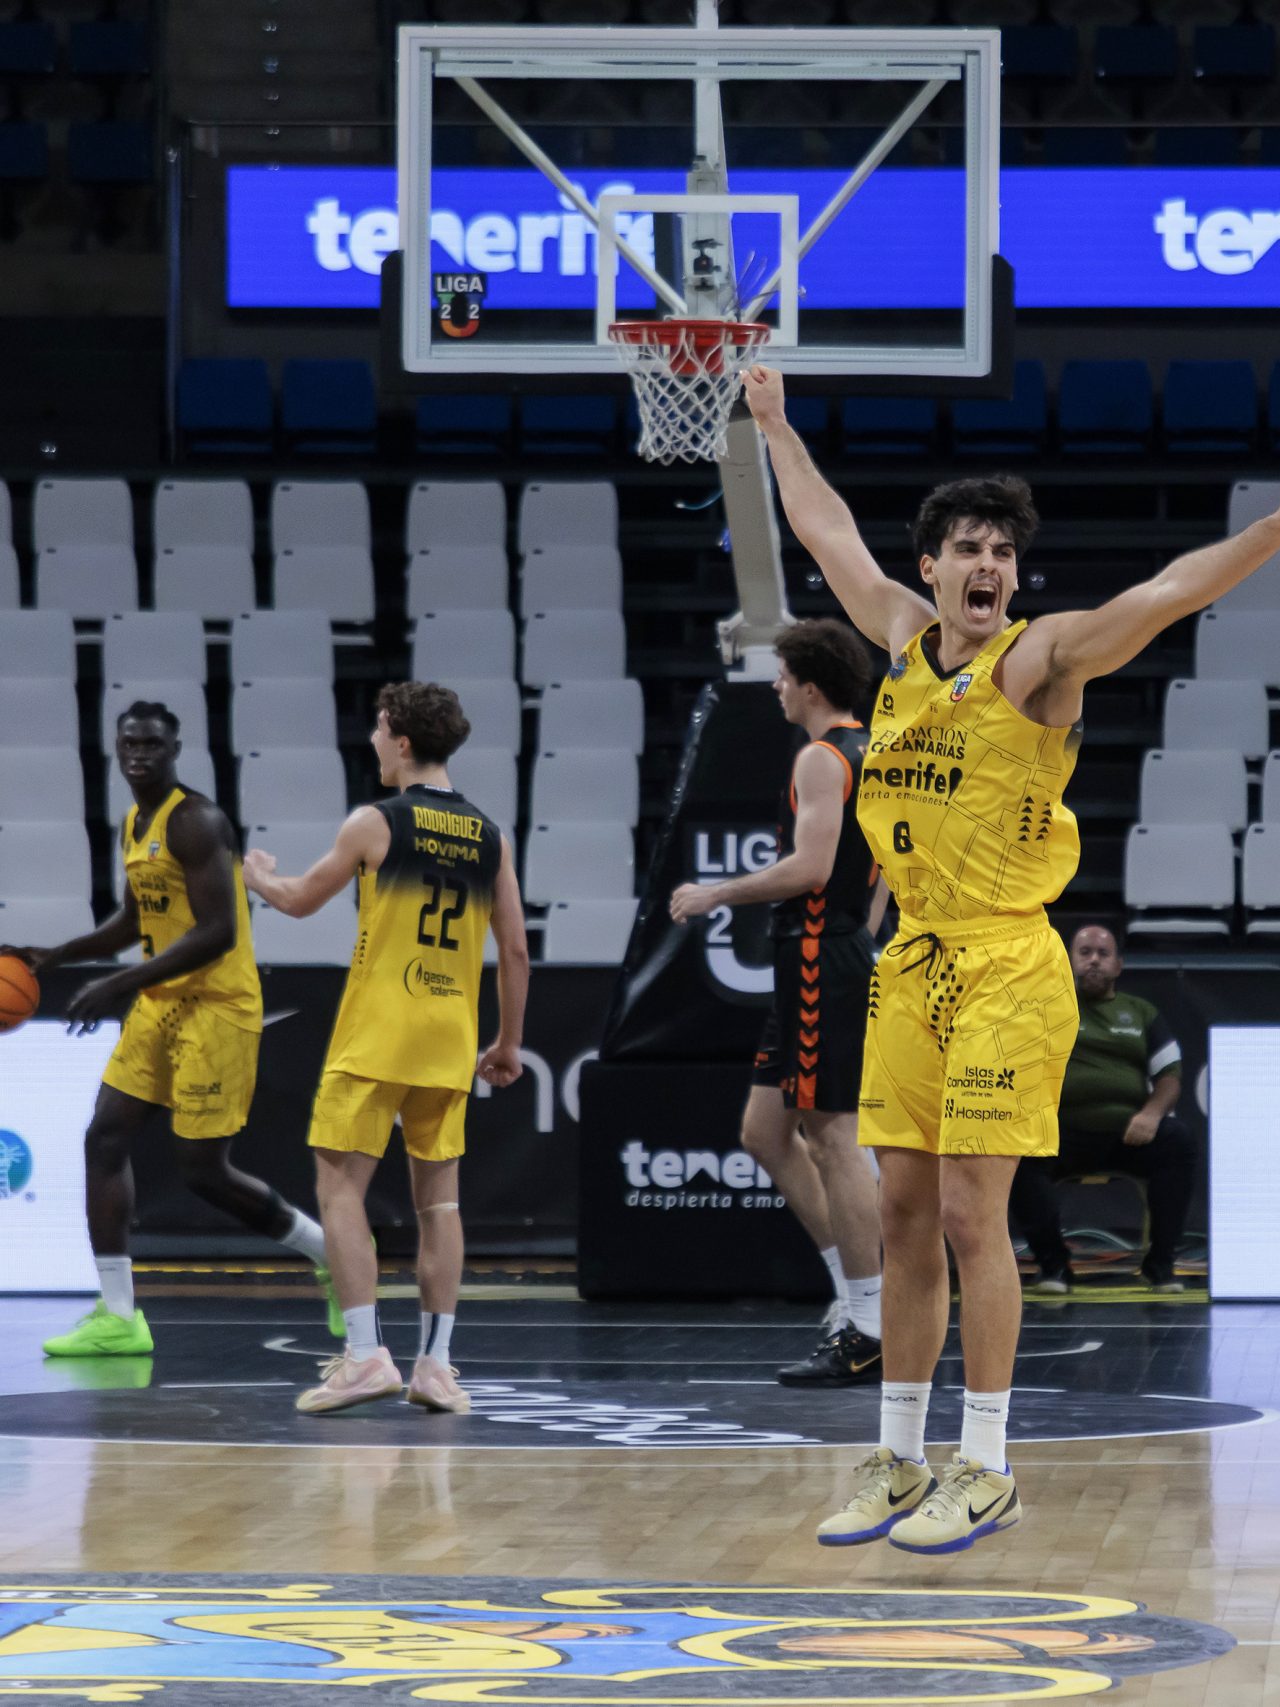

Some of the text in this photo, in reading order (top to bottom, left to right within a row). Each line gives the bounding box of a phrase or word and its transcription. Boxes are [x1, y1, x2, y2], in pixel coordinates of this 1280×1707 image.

[436, 276, 483, 293] LIGA
[879, 726, 968, 746] FDACIÓN
[889, 741, 965, 761] CANARIAS
[413, 806, 483, 842] RODRÍGUEZ
[414, 836, 480, 864] HOVIMA
[697, 832, 779, 874] LIG
[417, 872, 469, 951] 22
[707, 904, 733, 944] 2
[946, 1076, 994, 1090] Canarias
[965, 1066, 995, 1079] Islas
[955, 1106, 1013, 1123] Hospiten
[627, 1189, 733, 1211] despierta
